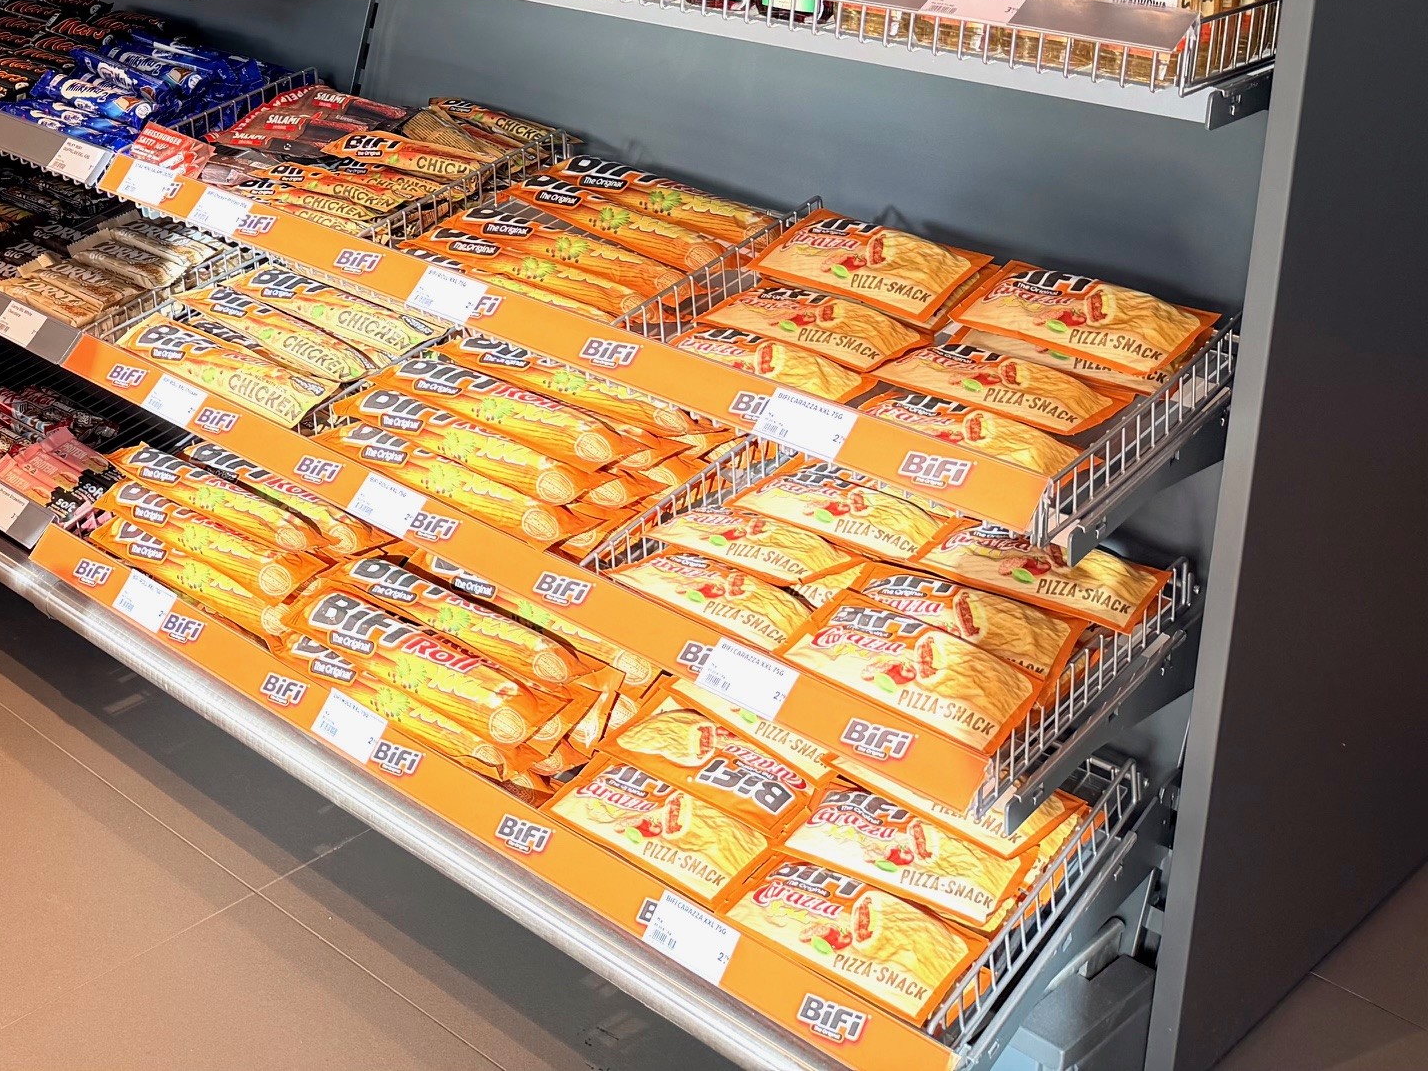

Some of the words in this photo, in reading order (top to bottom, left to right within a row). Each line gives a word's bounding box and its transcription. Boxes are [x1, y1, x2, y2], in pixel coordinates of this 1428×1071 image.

[315, 90, 347, 104] SALAMI
[265, 113, 301, 126] SALAMI
[333, 182, 396, 209] CHICKEN
[595, 177, 623, 190] Original
[302, 195, 367, 220] CHICKEN
[336, 248, 382, 270] BiFi
[851, 273, 930, 303] PIZZA-SNACK
[338, 310, 408, 350] CHICKEN
[1069, 329, 1164, 361] PIZZA-SNACK
[582, 340, 636, 365] BiFi
[109, 365, 146, 385] BiFi
[228, 372, 299, 421] CHICKEN
[901, 453, 969, 484] BiFi
[56, 497, 76, 514] soft
[1036, 577, 1130, 616] PIZZA-SNACK
[332, 633, 343, 643] The
[343, 637, 370, 653] Original
[406, 638, 481, 674] Roll
[898, 688, 995, 736] PIZZA-SNACK
[842, 717, 912, 755] BiFi
[833, 953, 927, 1001] PIZZA-SNACK
[798, 993, 868, 1039] BiFi
